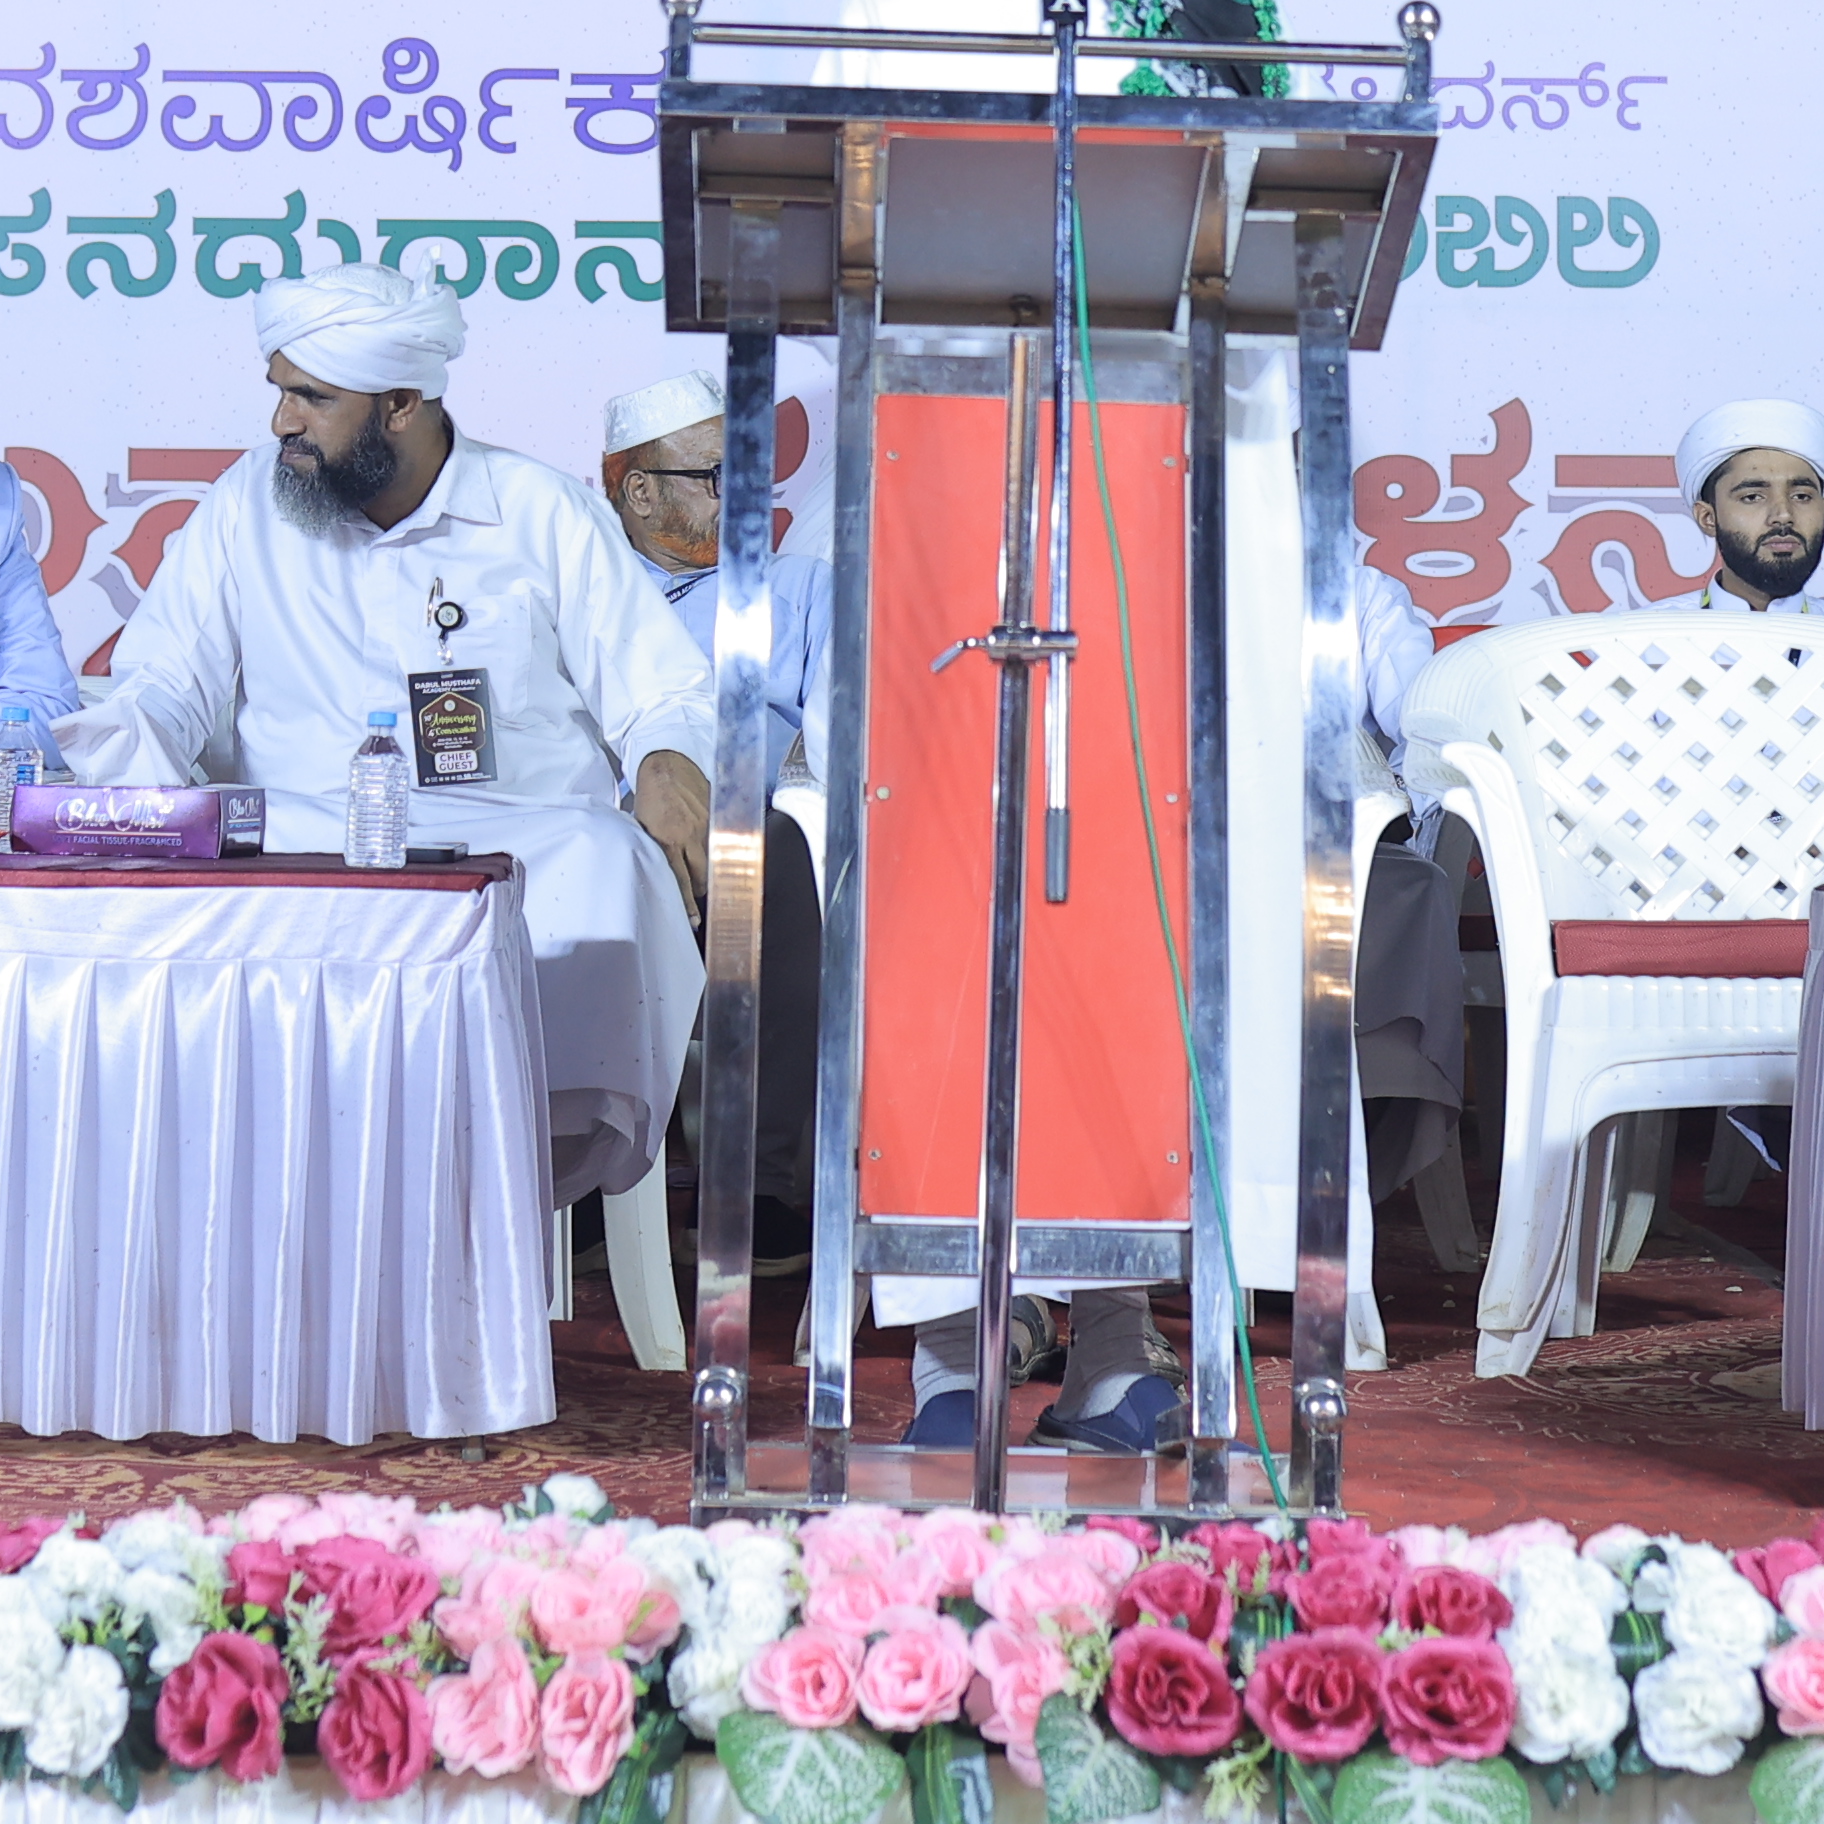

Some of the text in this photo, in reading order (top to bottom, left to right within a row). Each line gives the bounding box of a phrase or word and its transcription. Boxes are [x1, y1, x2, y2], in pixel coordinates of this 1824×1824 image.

[439, 752, 472, 762] CHIEF
[439, 761, 474, 771] GUEST
[73, 836, 100, 844] FACIAL
